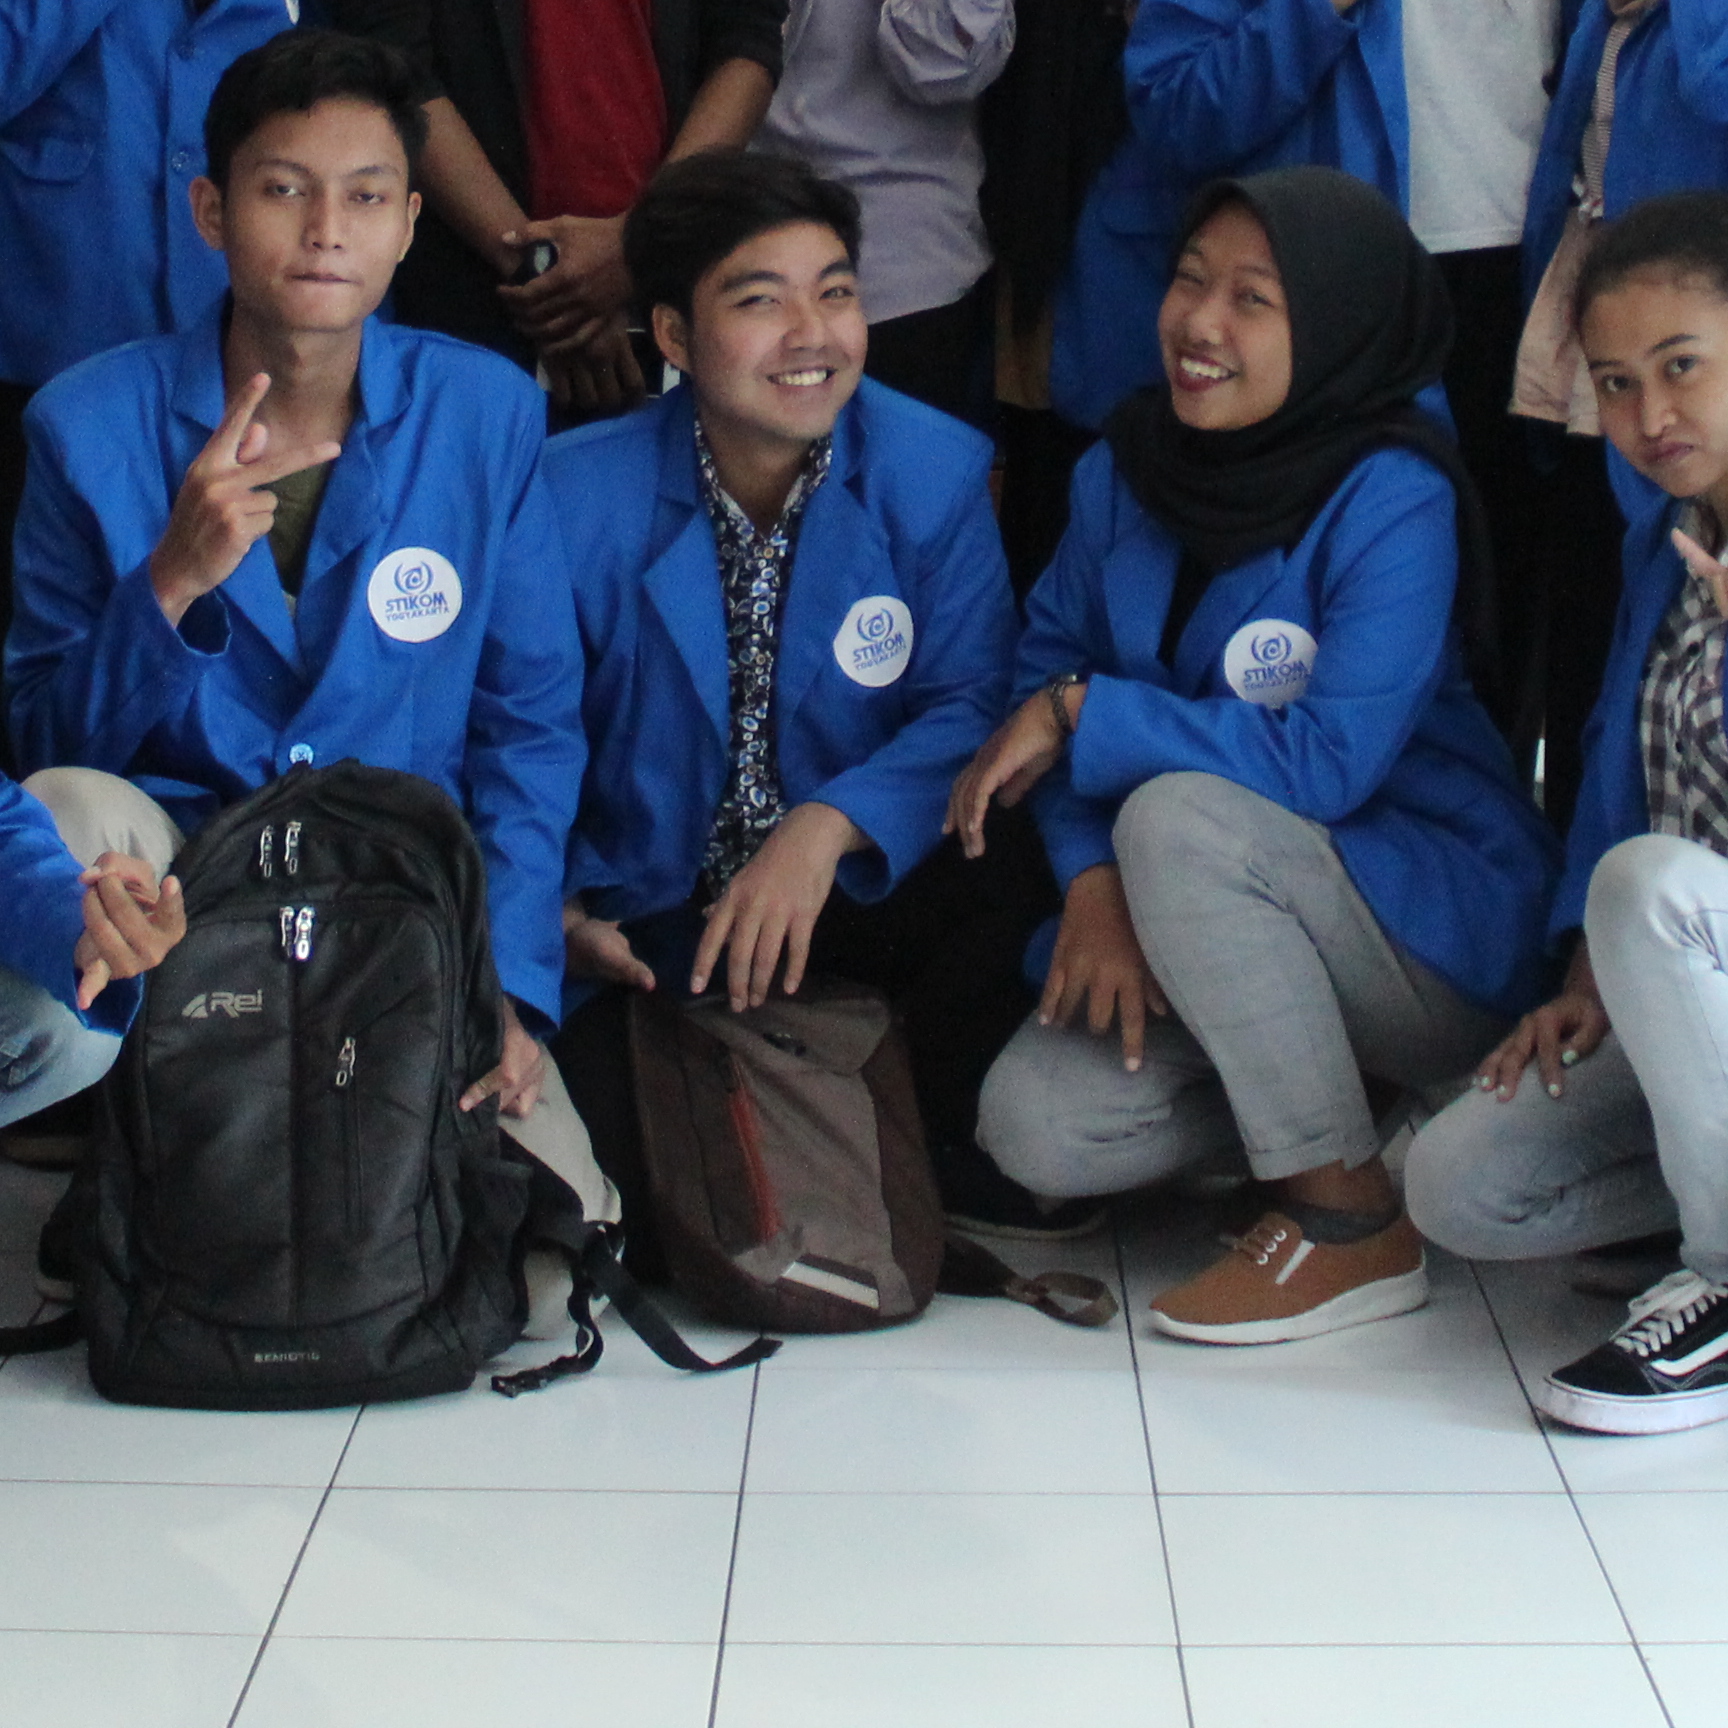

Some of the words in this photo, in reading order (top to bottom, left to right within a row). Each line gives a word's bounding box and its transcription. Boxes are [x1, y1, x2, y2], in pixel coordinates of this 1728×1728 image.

[385, 591, 448, 613] STIKOM
[385, 606, 450, 622] YOGYAKARTA
[853, 630, 906, 664] STIKOM
[1243, 659, 1311, 682] STIKOM
